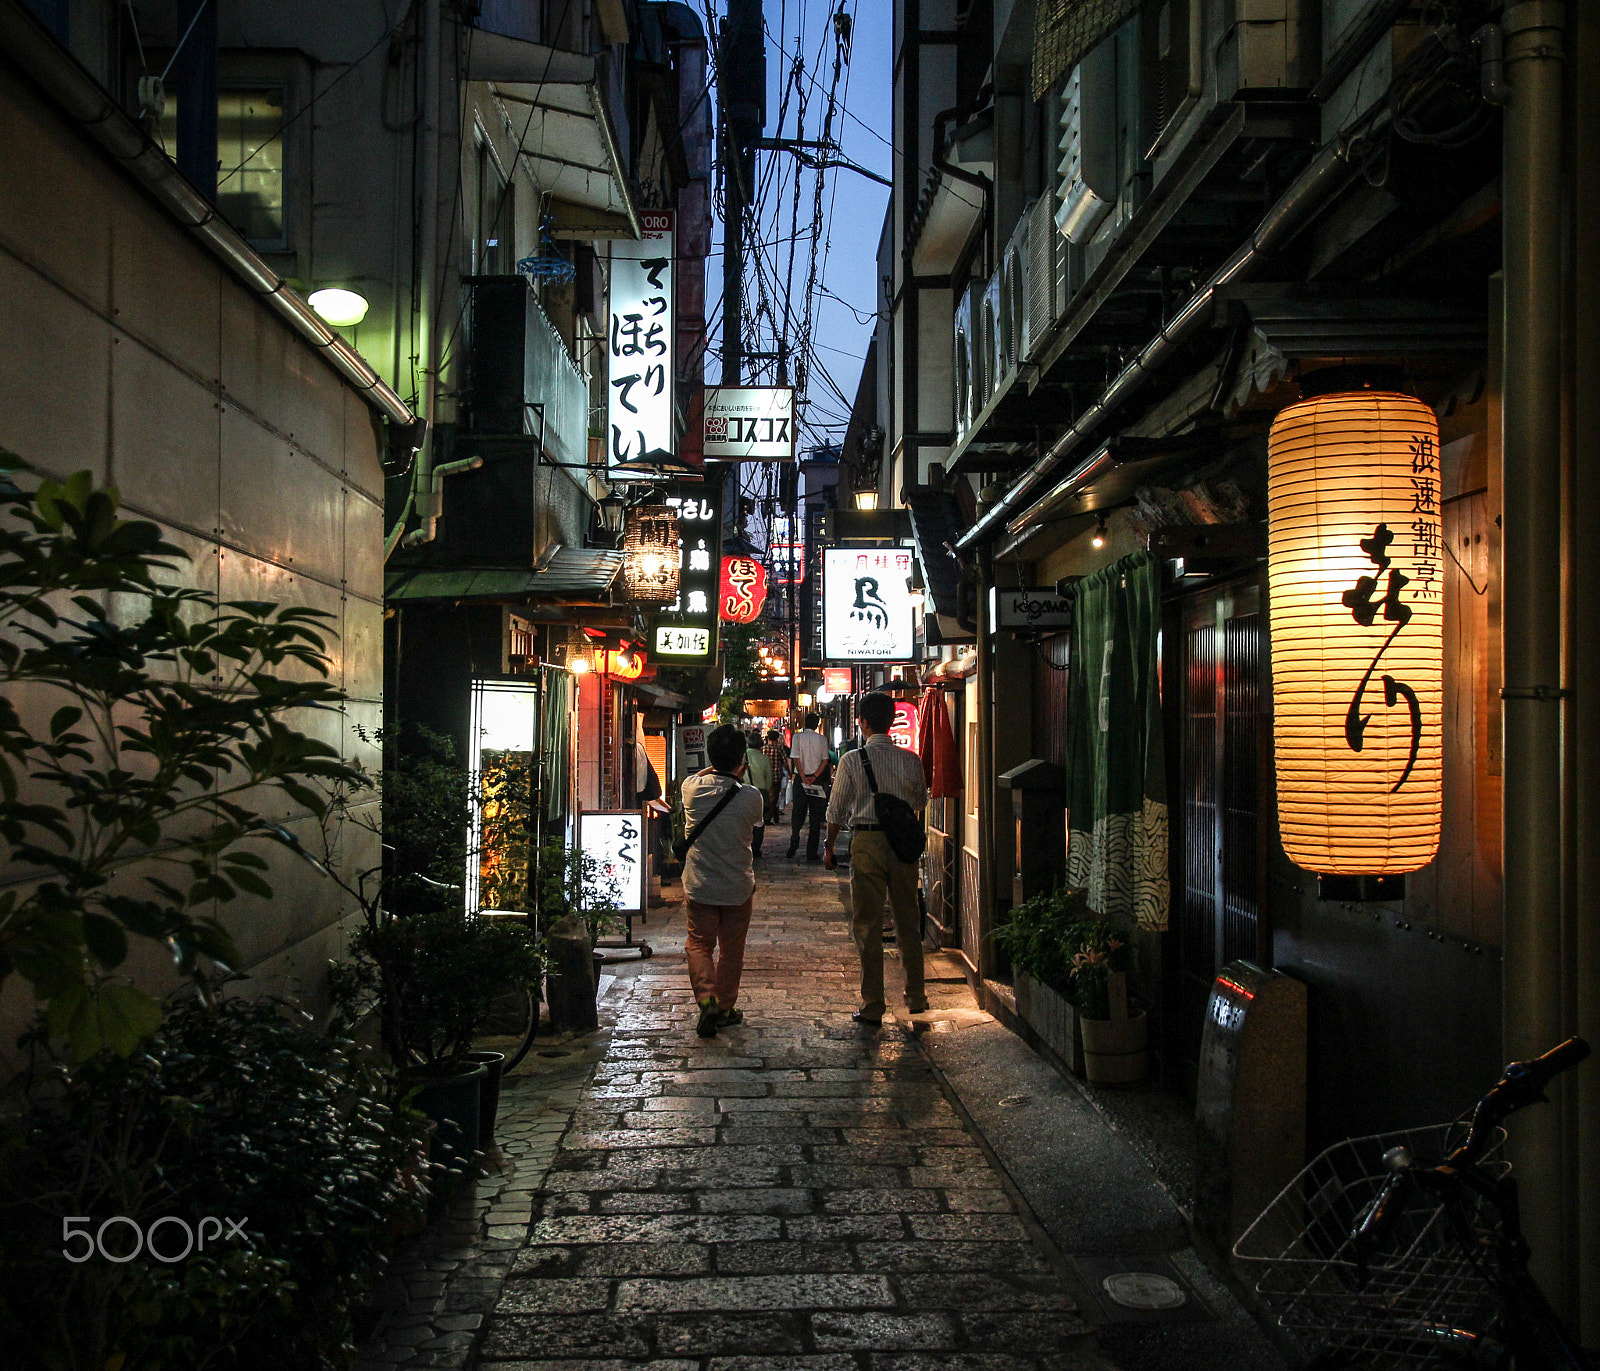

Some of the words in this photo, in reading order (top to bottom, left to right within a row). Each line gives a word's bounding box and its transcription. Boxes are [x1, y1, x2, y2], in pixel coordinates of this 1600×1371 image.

[641, 216, 669, 228] ORO
[640, 256, 669, 396] てっちり
[611, 313, 646, 464] ほてい
[728, 417, 789, 442] コスコス
[1408, 434, 1438, 599] 浪速割烹
[856, 554, 909, 570] 月桂冠
[726, 559, 757, 617] ほてい
[617, 819, 639, 864] ふぐ
